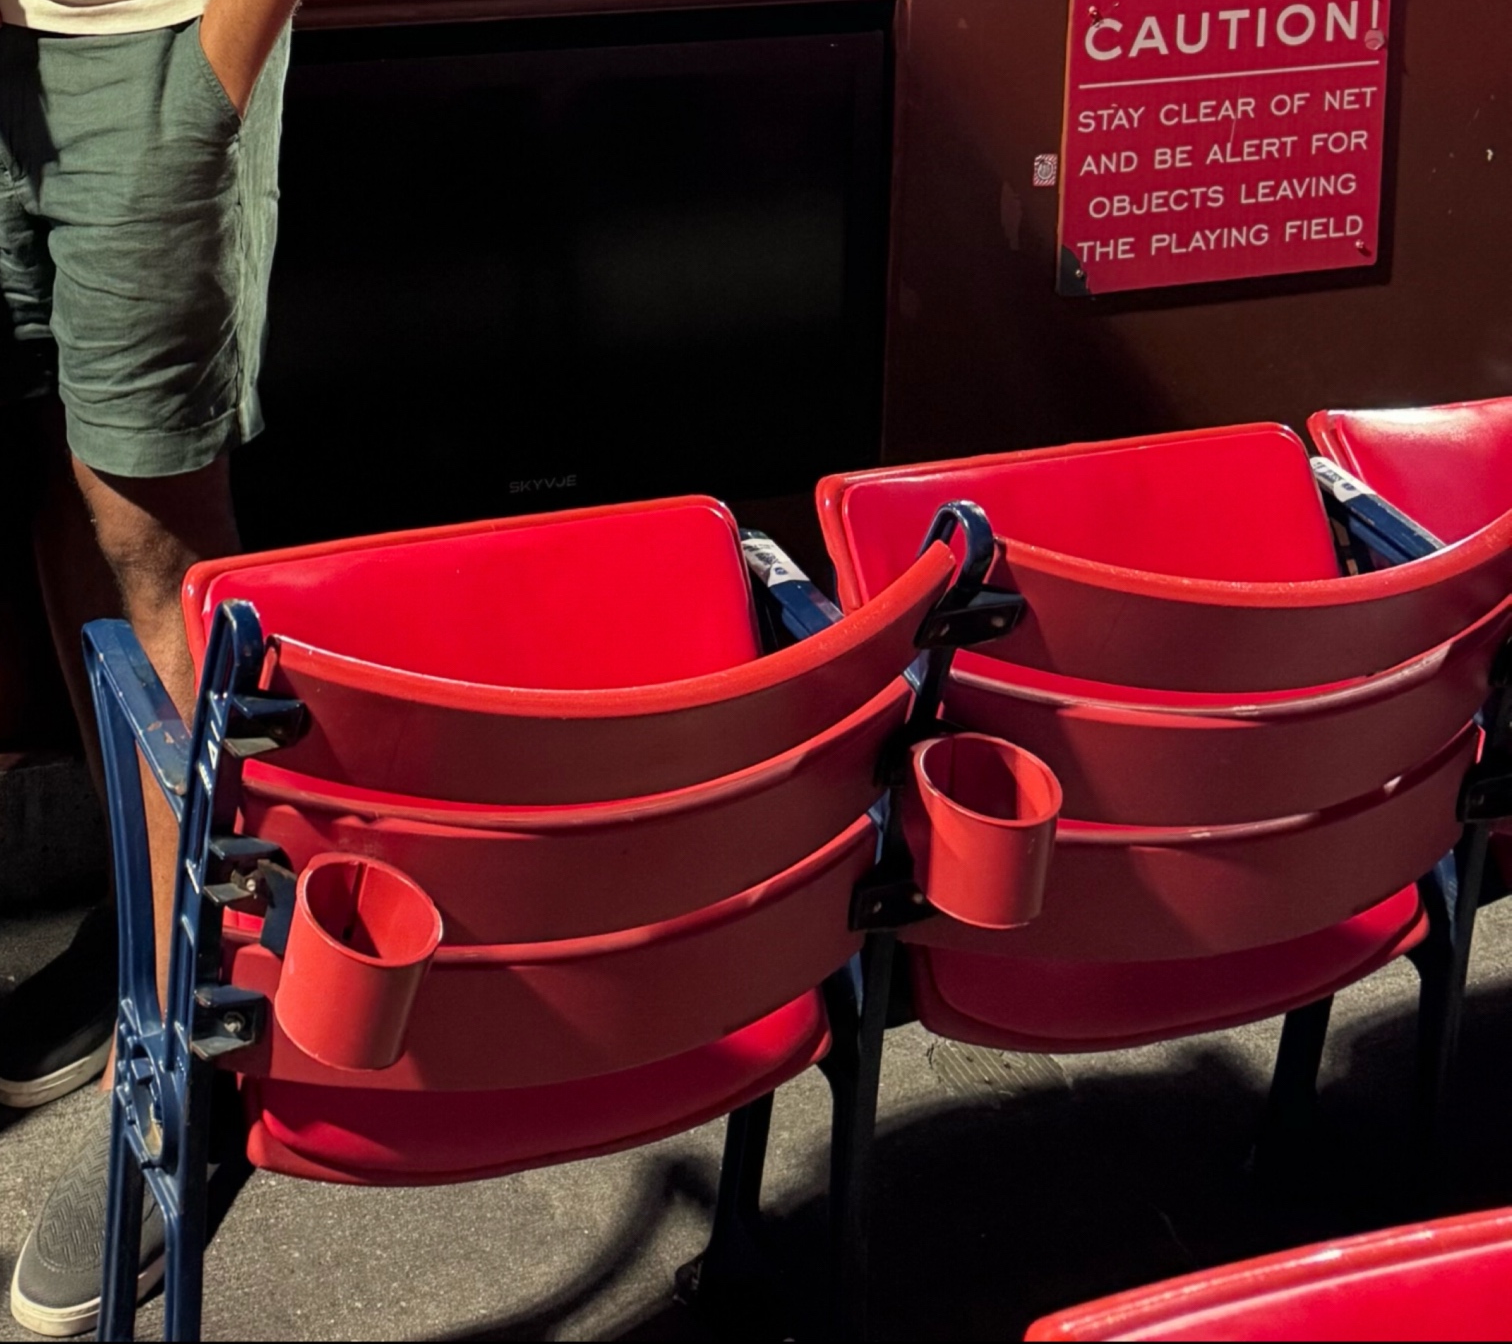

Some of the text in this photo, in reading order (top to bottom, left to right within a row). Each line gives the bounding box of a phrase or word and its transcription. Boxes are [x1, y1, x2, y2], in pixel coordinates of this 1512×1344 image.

[1078, 87, 1377, 133] STAY CLEAR OF NET
[1079, 130, 1368, 177] AND BE ALERT FOR
[1089, 173, 1356, 218] OBJECTS LEAVING
[1077, 215, 1363, 263] THE PLAYING FIELD
